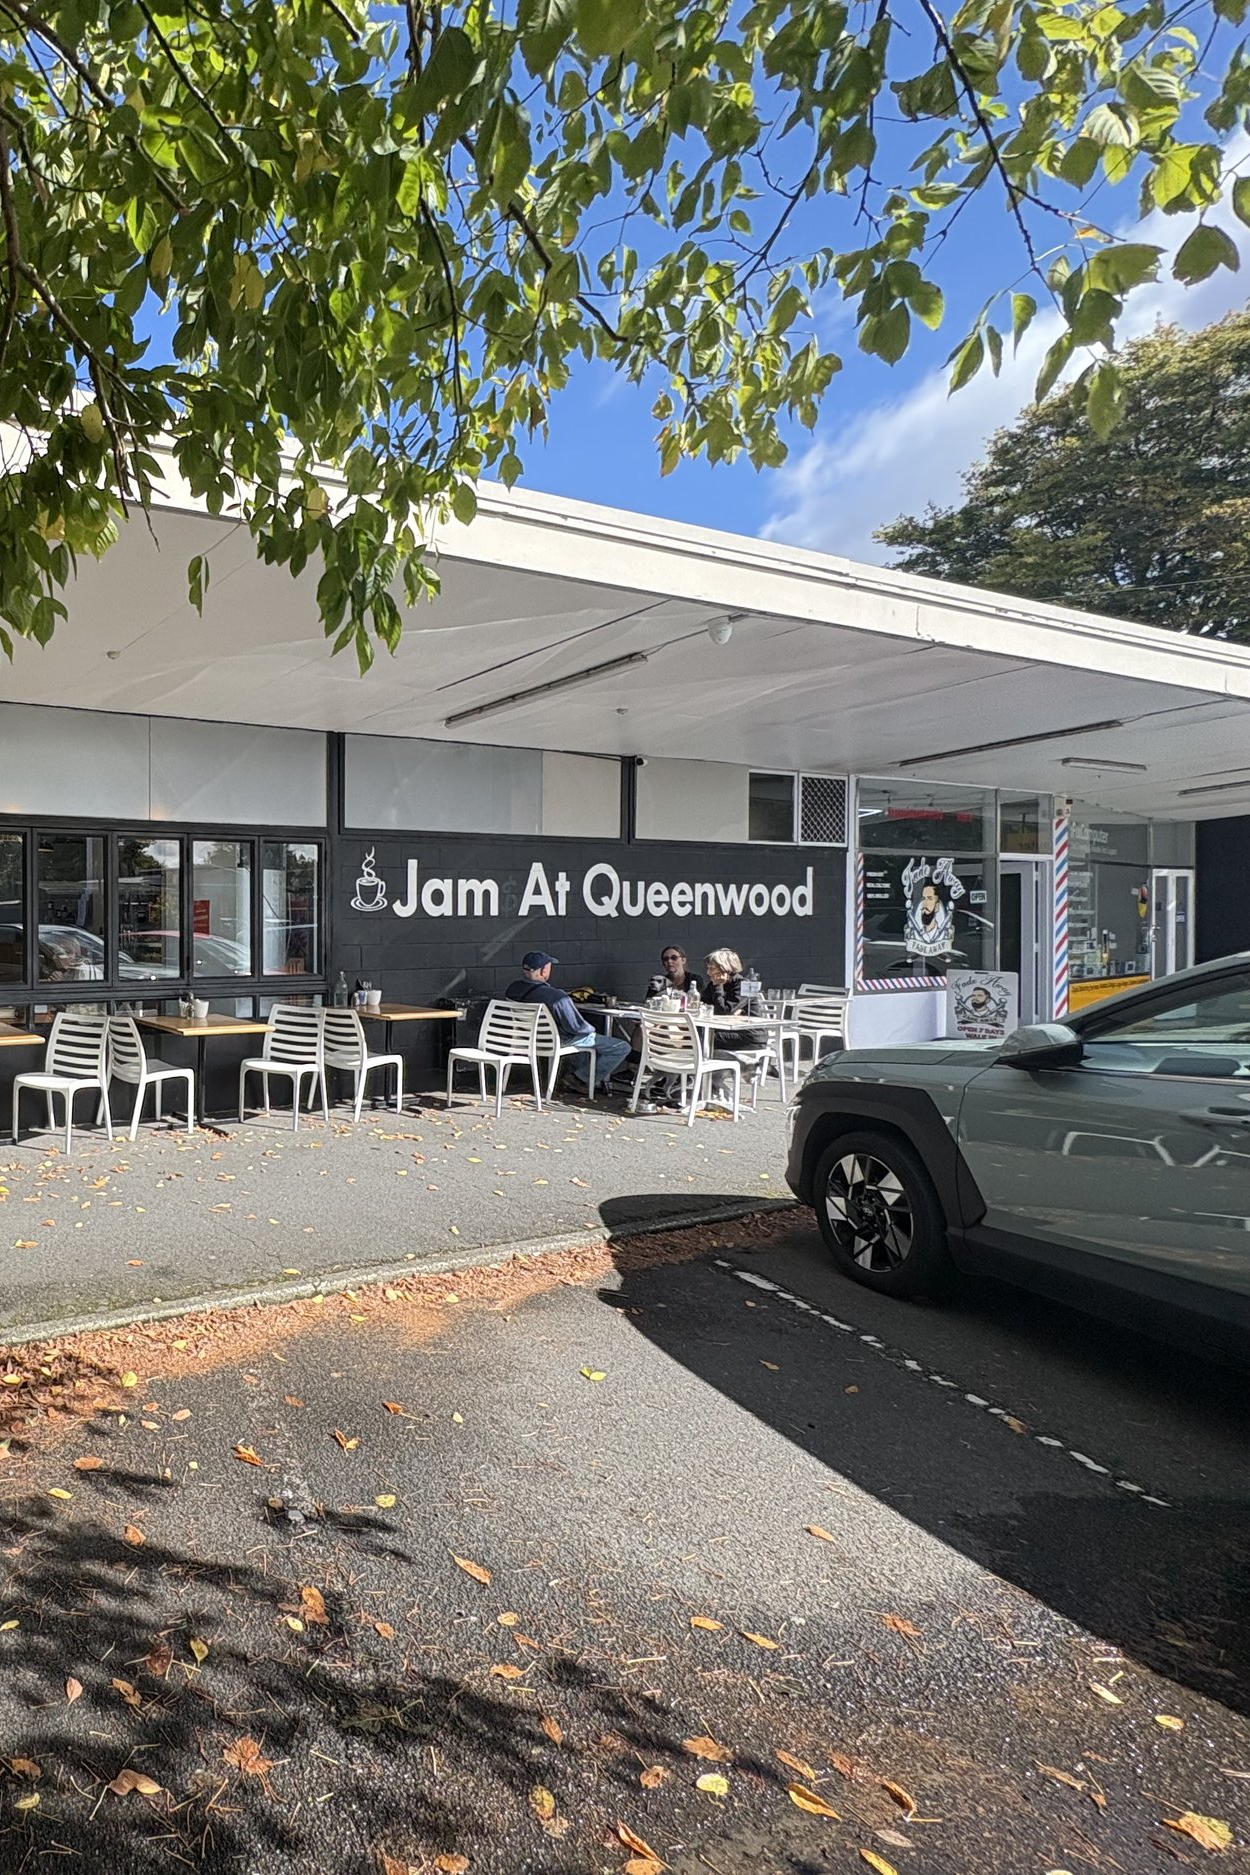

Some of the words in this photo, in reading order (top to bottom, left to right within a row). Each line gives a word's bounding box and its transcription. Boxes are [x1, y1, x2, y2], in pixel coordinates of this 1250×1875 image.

[901, 857, 930, 899] Fade
[932, 857, 966, 899] Away
[392, 858, 499, 918] Jam
[517, 861, 571, 917] At
[582, 862, 814, 918] Queenwood
[971, 892, 986, 902] OPEN
[951, 976, 976, 992] Fade
[985, 1028, 1005, 1036] DAYS
